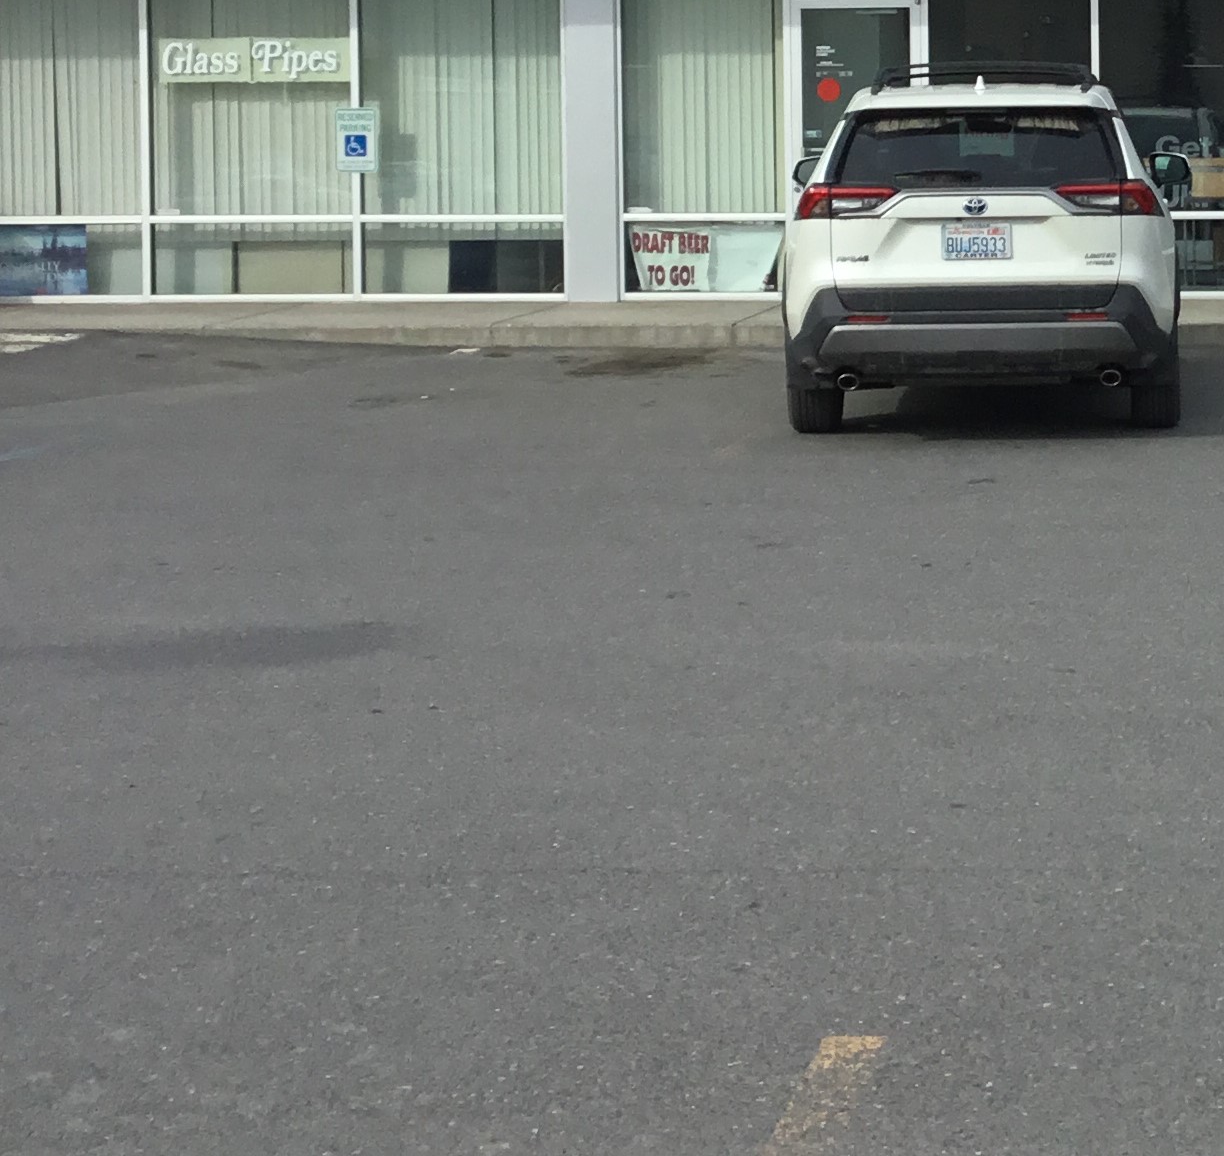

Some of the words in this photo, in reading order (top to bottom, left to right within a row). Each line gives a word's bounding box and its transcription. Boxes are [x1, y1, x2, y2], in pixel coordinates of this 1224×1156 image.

[162, 42, 239, 75] Glass
[251, 41, 338, 79] Pipes
[1155, 135, 1212, 158] Get
[632, 231, 674, 254] DRAFT
[678, 231, 709, 254] BEER
[946, 237, 1006, 253] BUJ5933
[647, 265, 666, 286] TO
[669, 265, 695, 286] GO!
